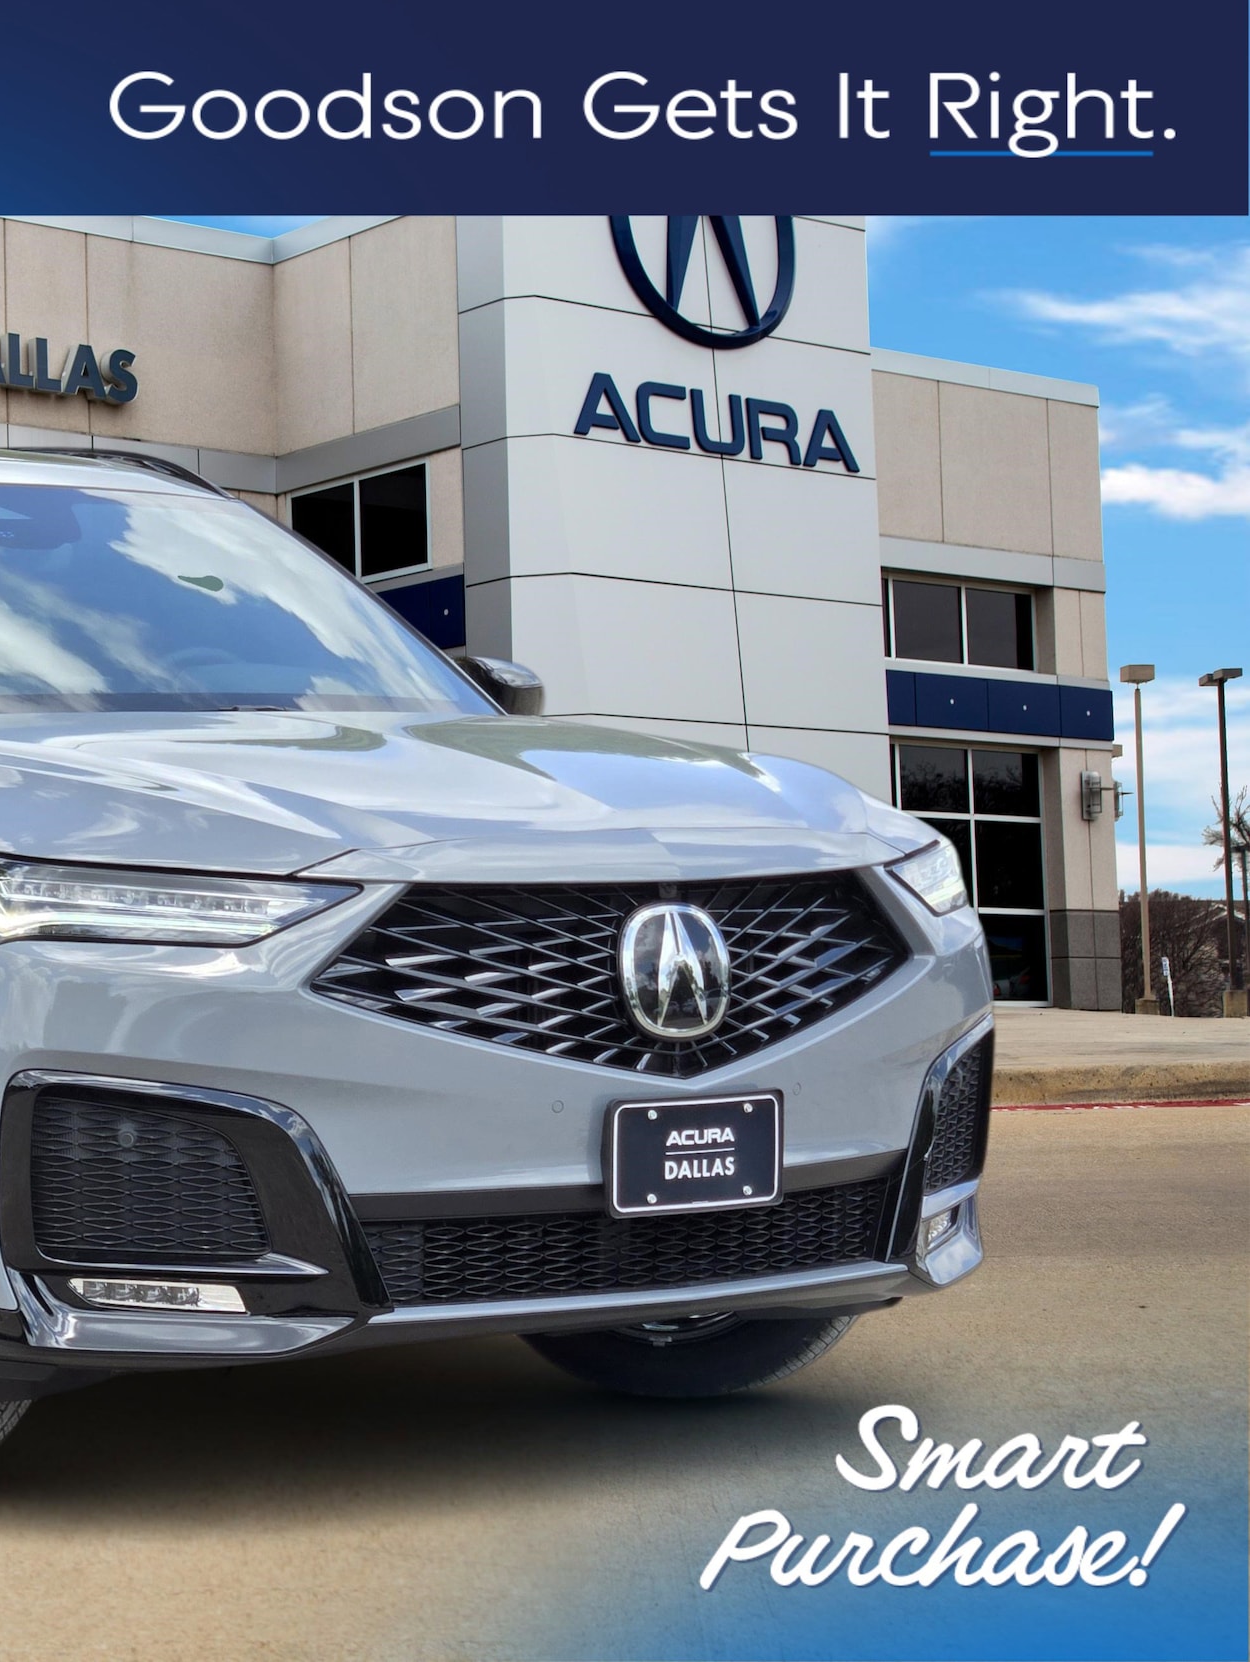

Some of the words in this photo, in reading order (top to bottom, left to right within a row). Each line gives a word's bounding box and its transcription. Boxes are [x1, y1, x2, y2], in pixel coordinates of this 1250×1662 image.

[573, 371, 860, 473] ACURA
[665, 1127, 735, 1147] ACURA
[664, 1156, 735, 1180] DALLAS
